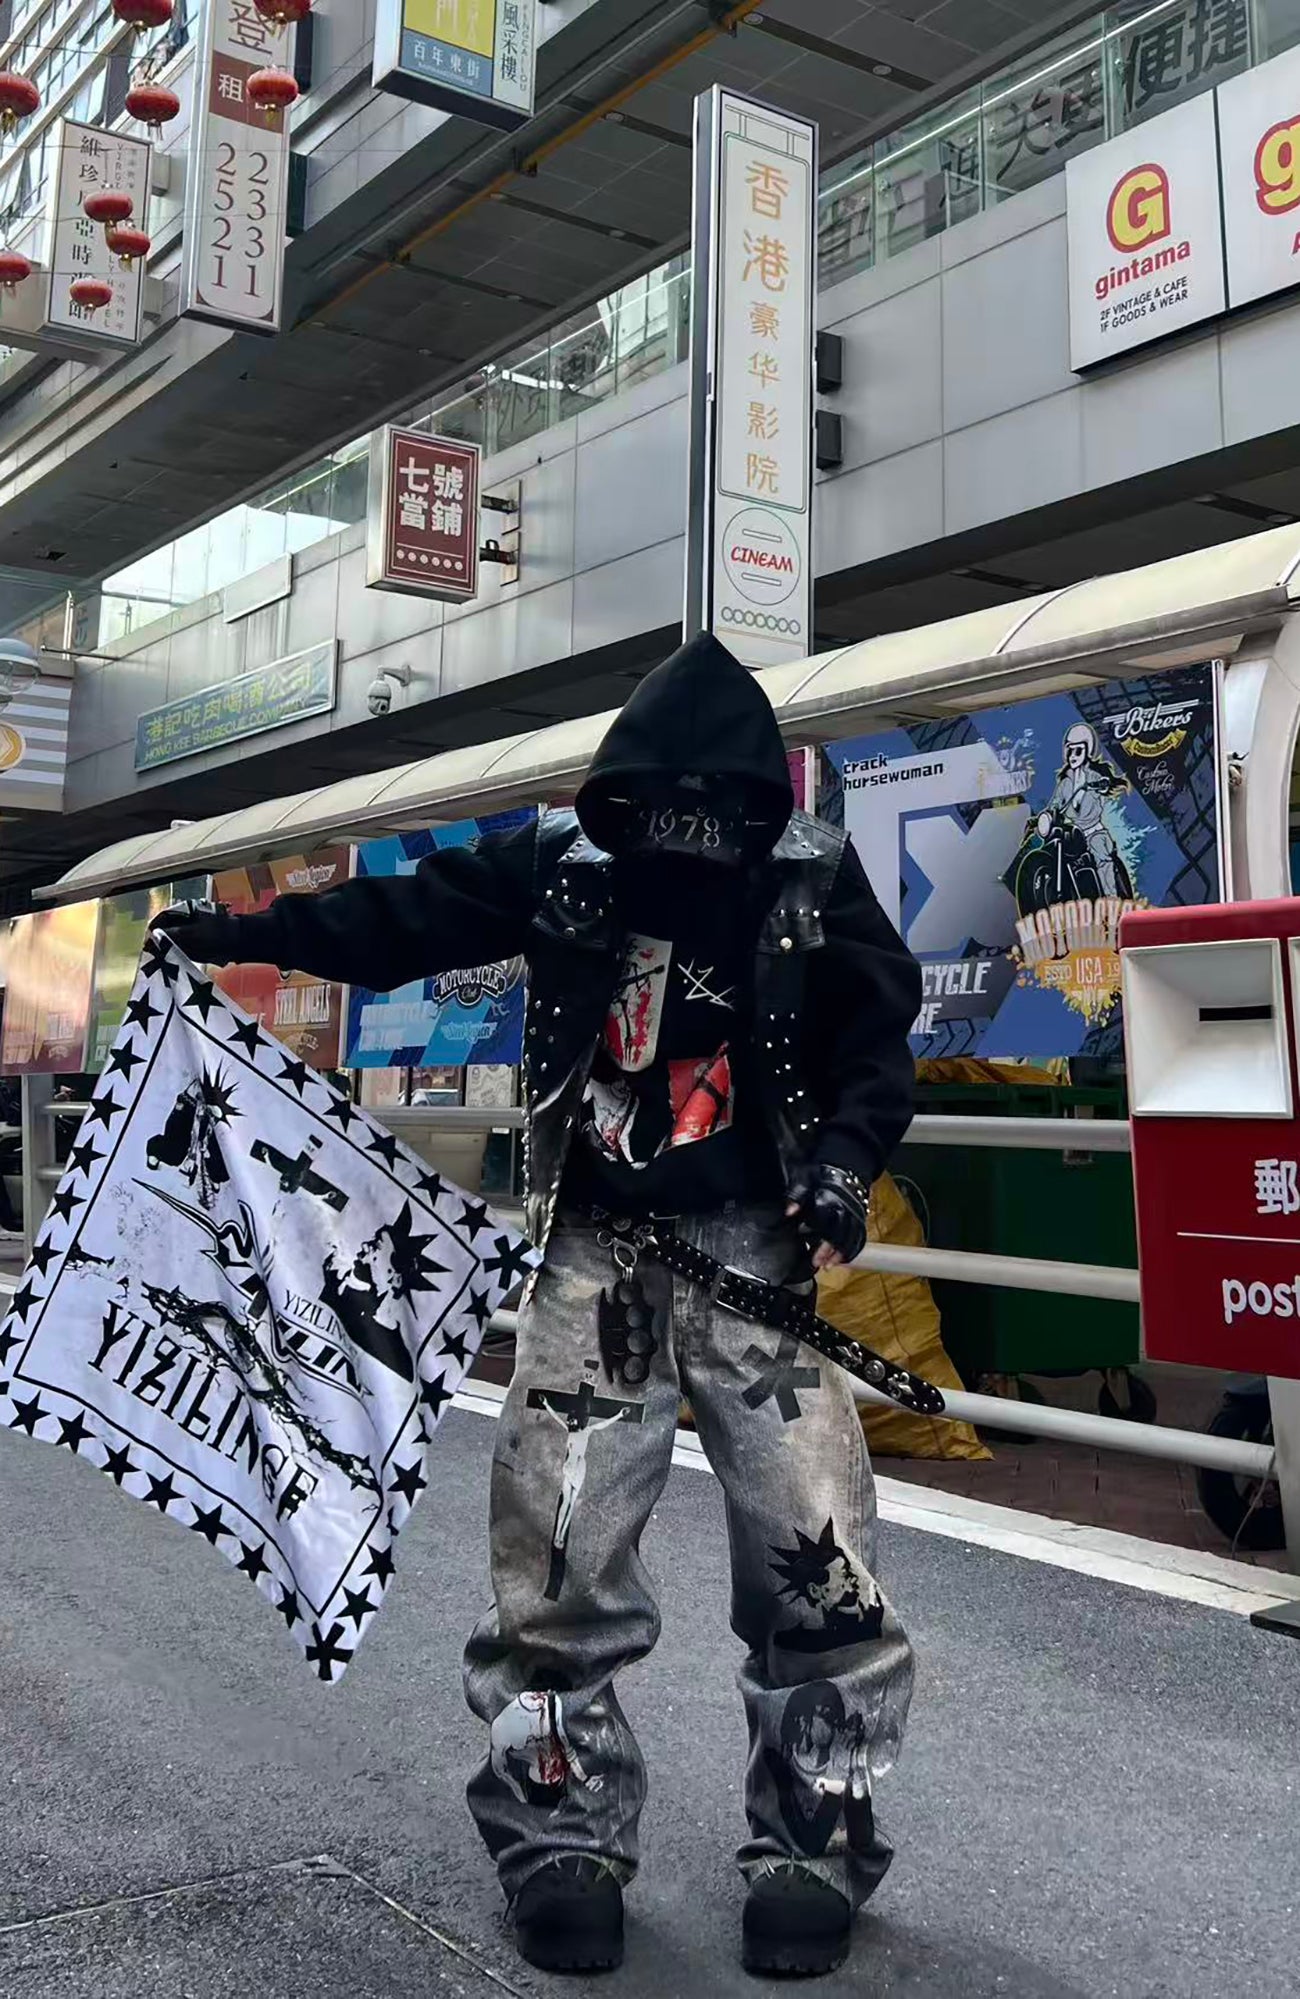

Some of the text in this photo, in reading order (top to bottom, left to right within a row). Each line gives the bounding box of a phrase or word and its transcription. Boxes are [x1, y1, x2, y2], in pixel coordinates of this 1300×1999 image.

[1095, 240, 1190, 300] gintama
[1100, 276, 1187, 321] 2F VINTAGE & CAFE
[1100, 289, 1188, 333] 1F GOODS & WEAR
[741, 160, 791, 495] 香港豪华影院
[400, 457, 464, 501] 七號
[730, 545, 793, 573] CINEAM
[1114, 702, 1193, 738] Bikers
[843, 754, 888, 774] crack
[843, 763, 943, 791] horsewoman
[439, 966, 501, 996] MOTORCYCLE
[921, 962, 992, 997] CYCLE
[1076, 957, 1103, 984] USA
[1254, 1158, 1300, 1215] 郵
